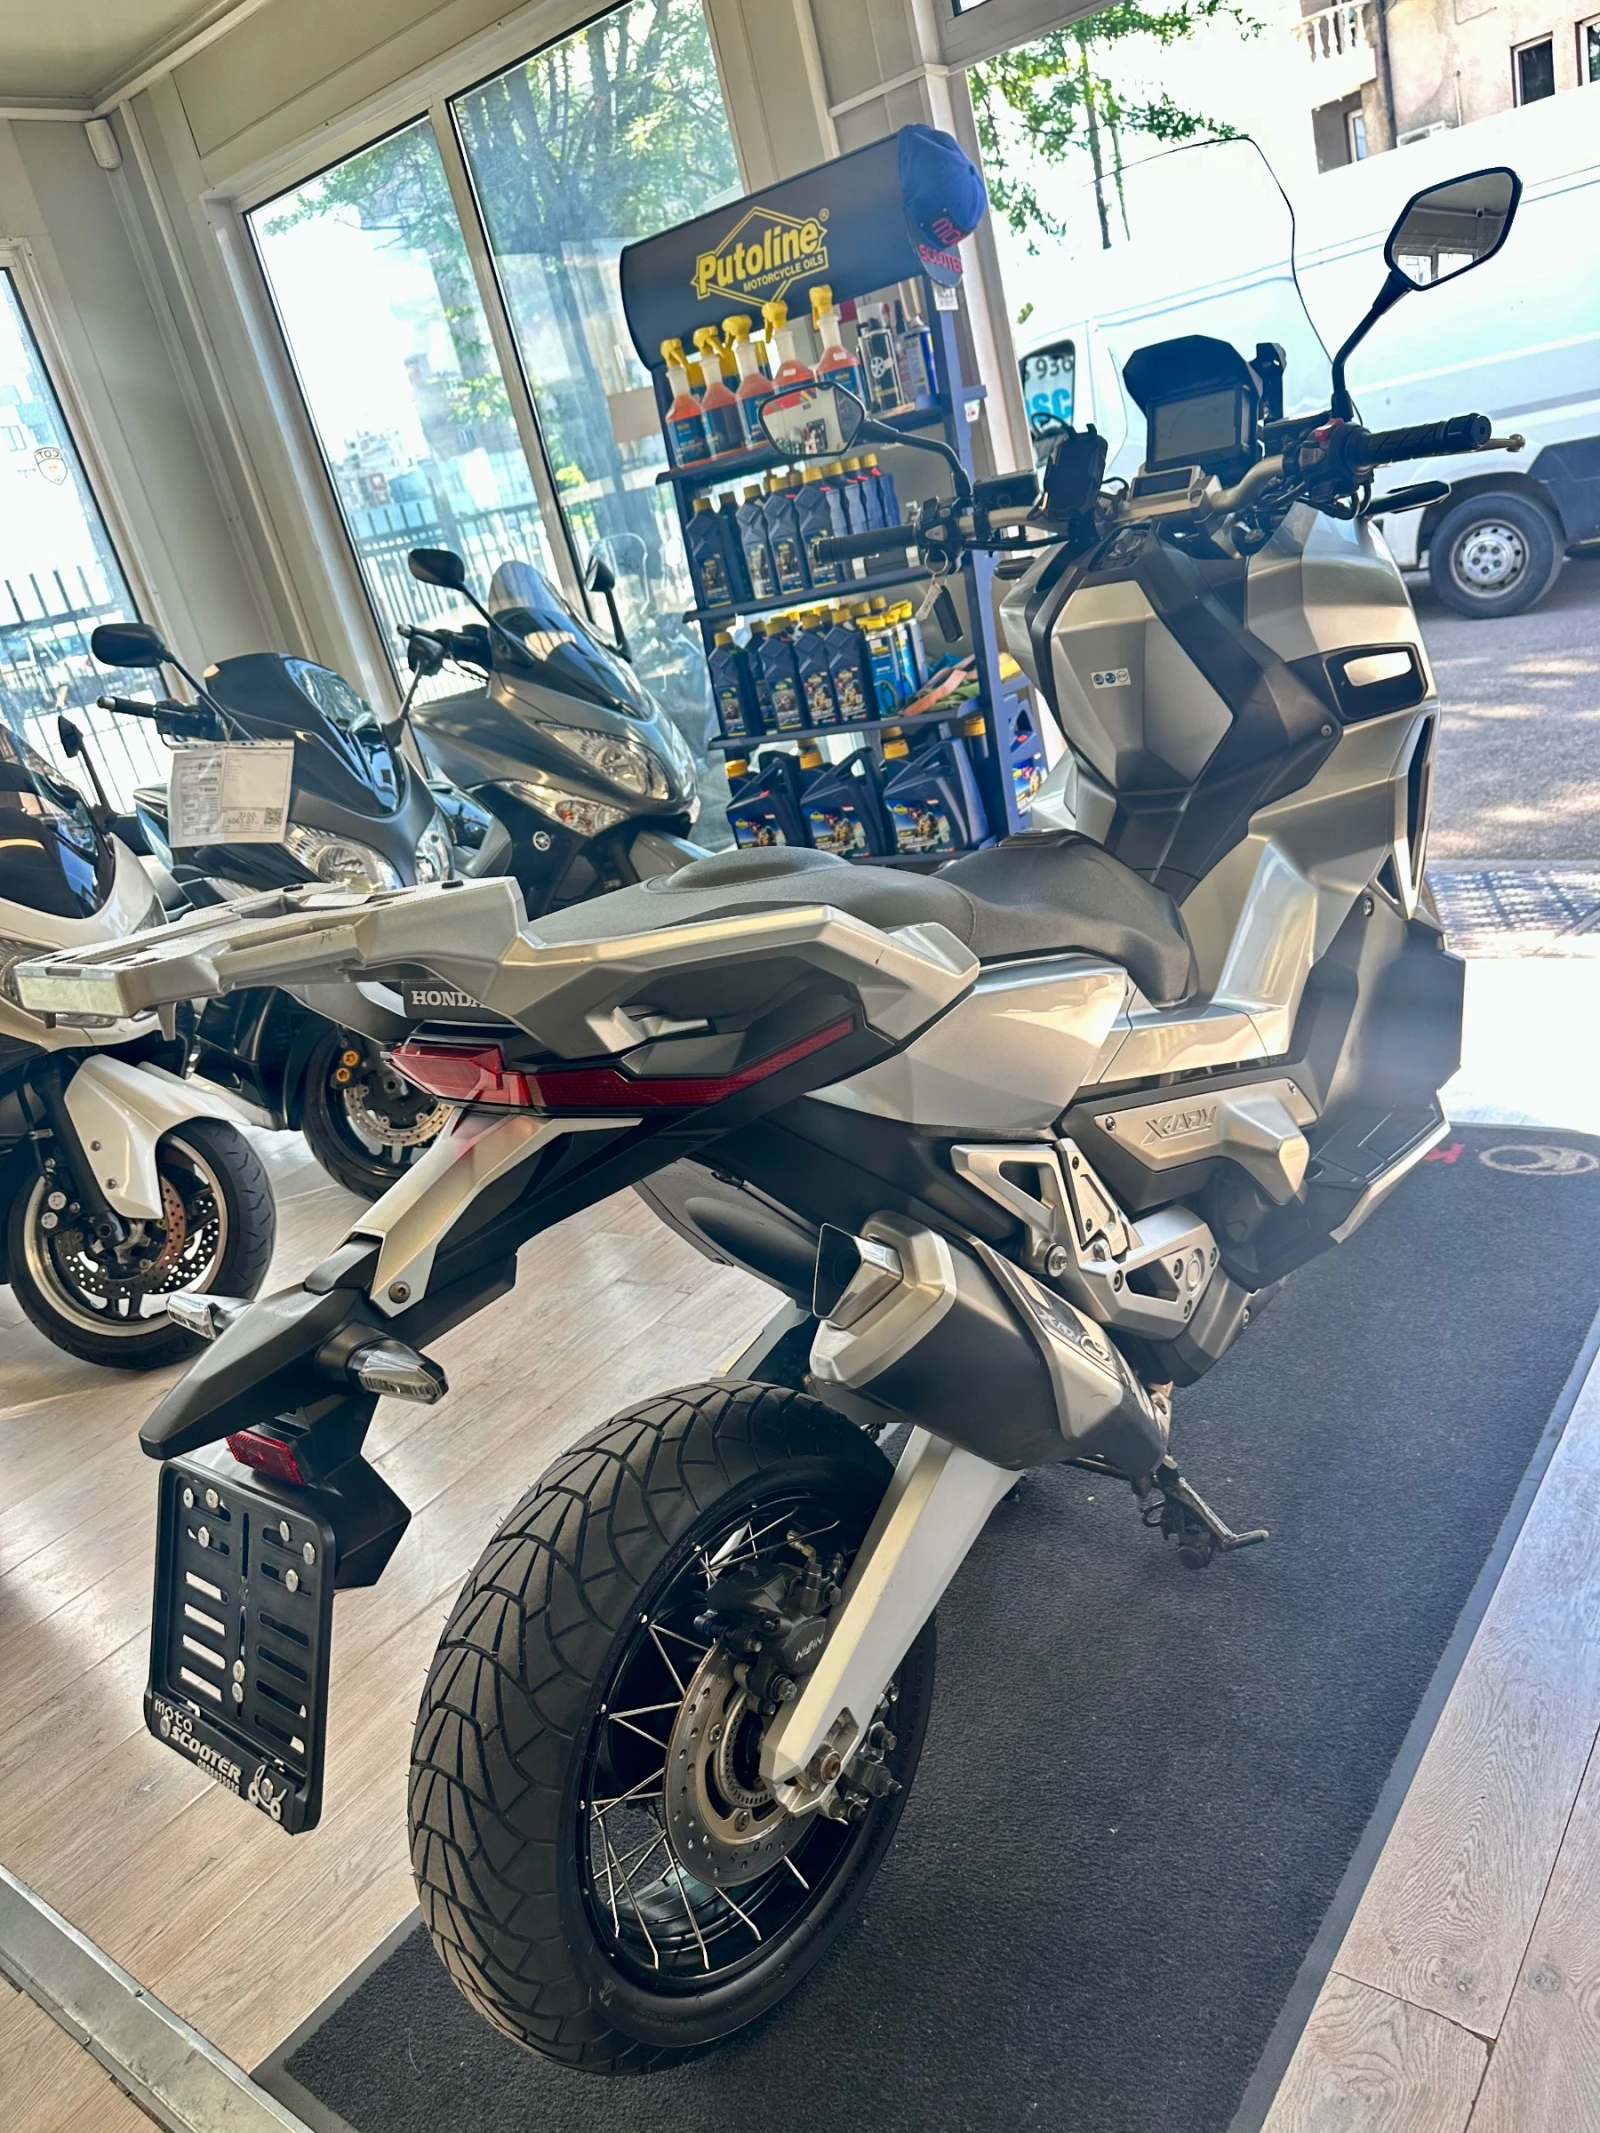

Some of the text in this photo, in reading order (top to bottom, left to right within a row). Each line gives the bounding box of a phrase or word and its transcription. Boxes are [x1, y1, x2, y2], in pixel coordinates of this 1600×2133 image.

[698, 222, 819, 294] Putoline
[743, 254, 824, 292] MOTORCYCLE OILS
[154, 1699, 193, 1733] moto
[170, 1725, 242, 1783] SCOOTER
